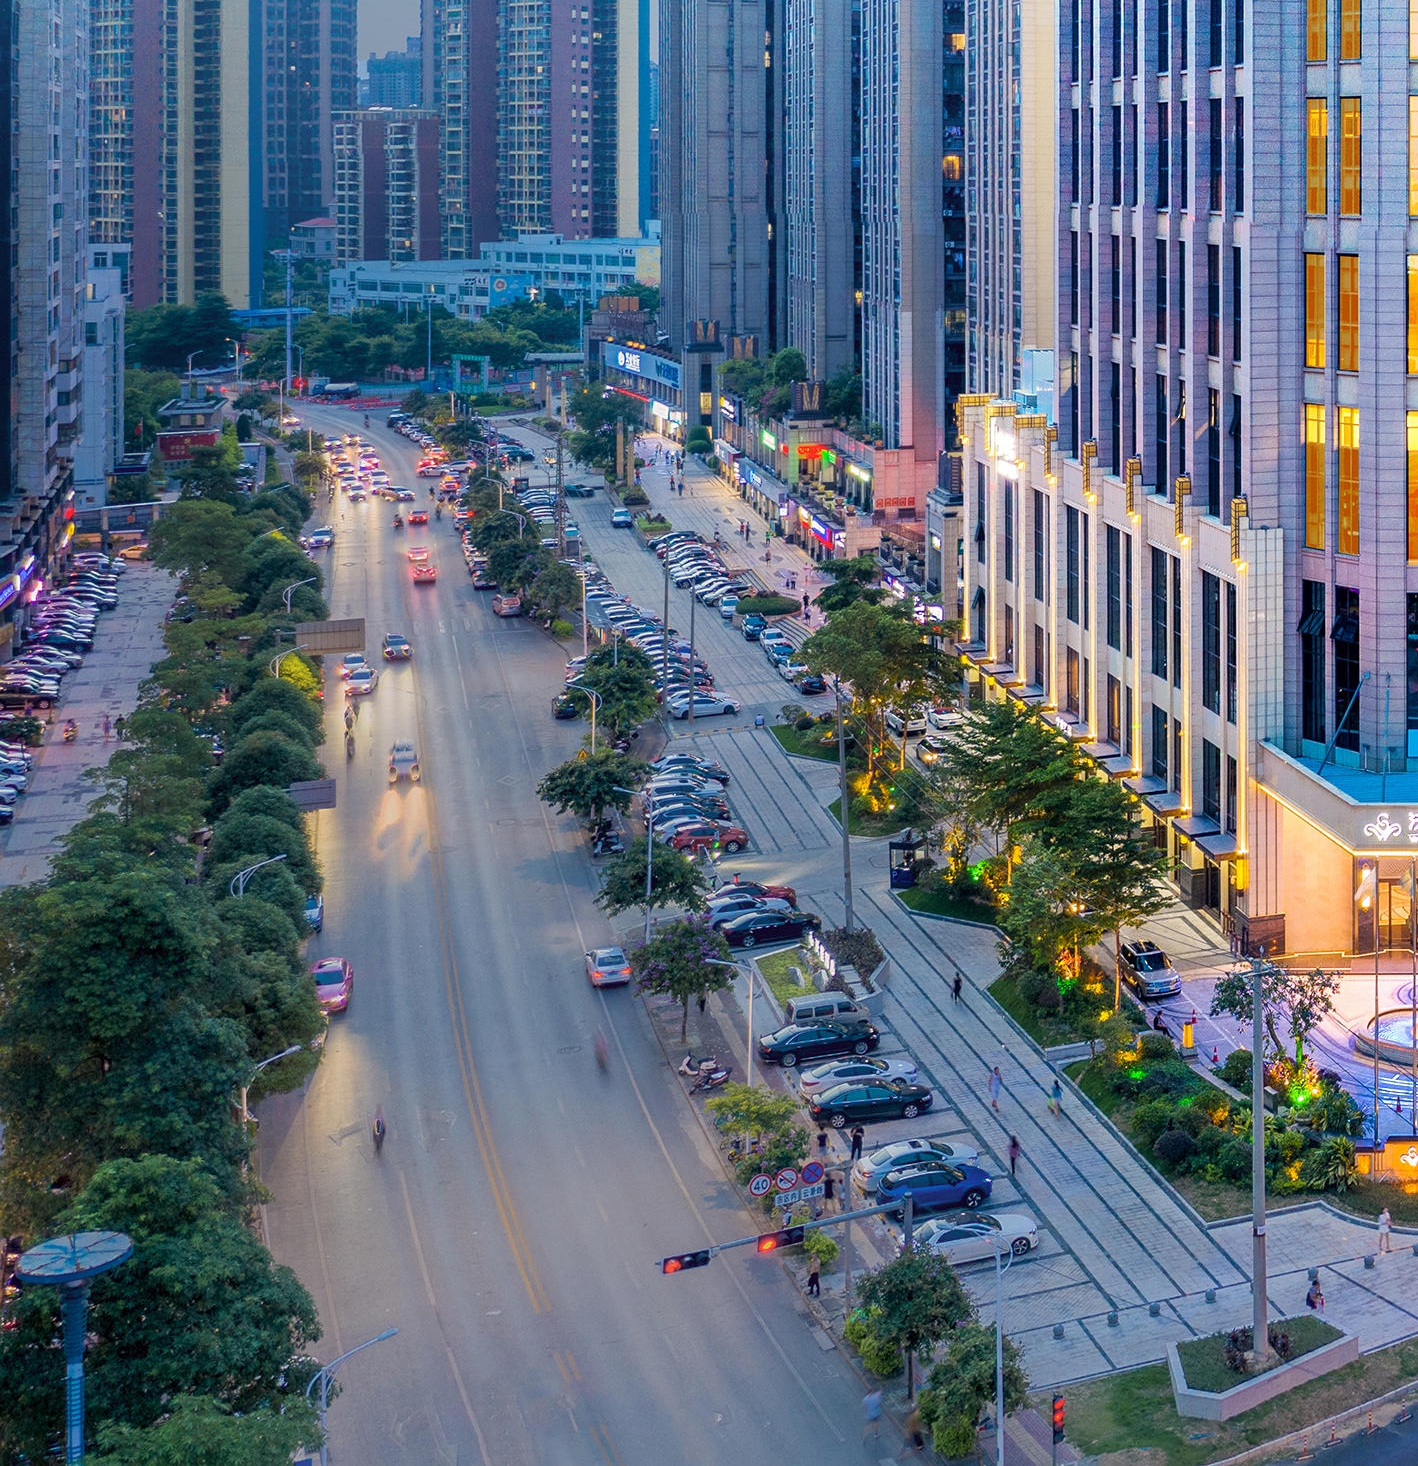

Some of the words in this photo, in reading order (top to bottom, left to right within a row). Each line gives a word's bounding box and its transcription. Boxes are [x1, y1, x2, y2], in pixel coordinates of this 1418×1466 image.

[754, 1179, 769, 1192] 40
[776, 1192, 797, 1205] 市区内
